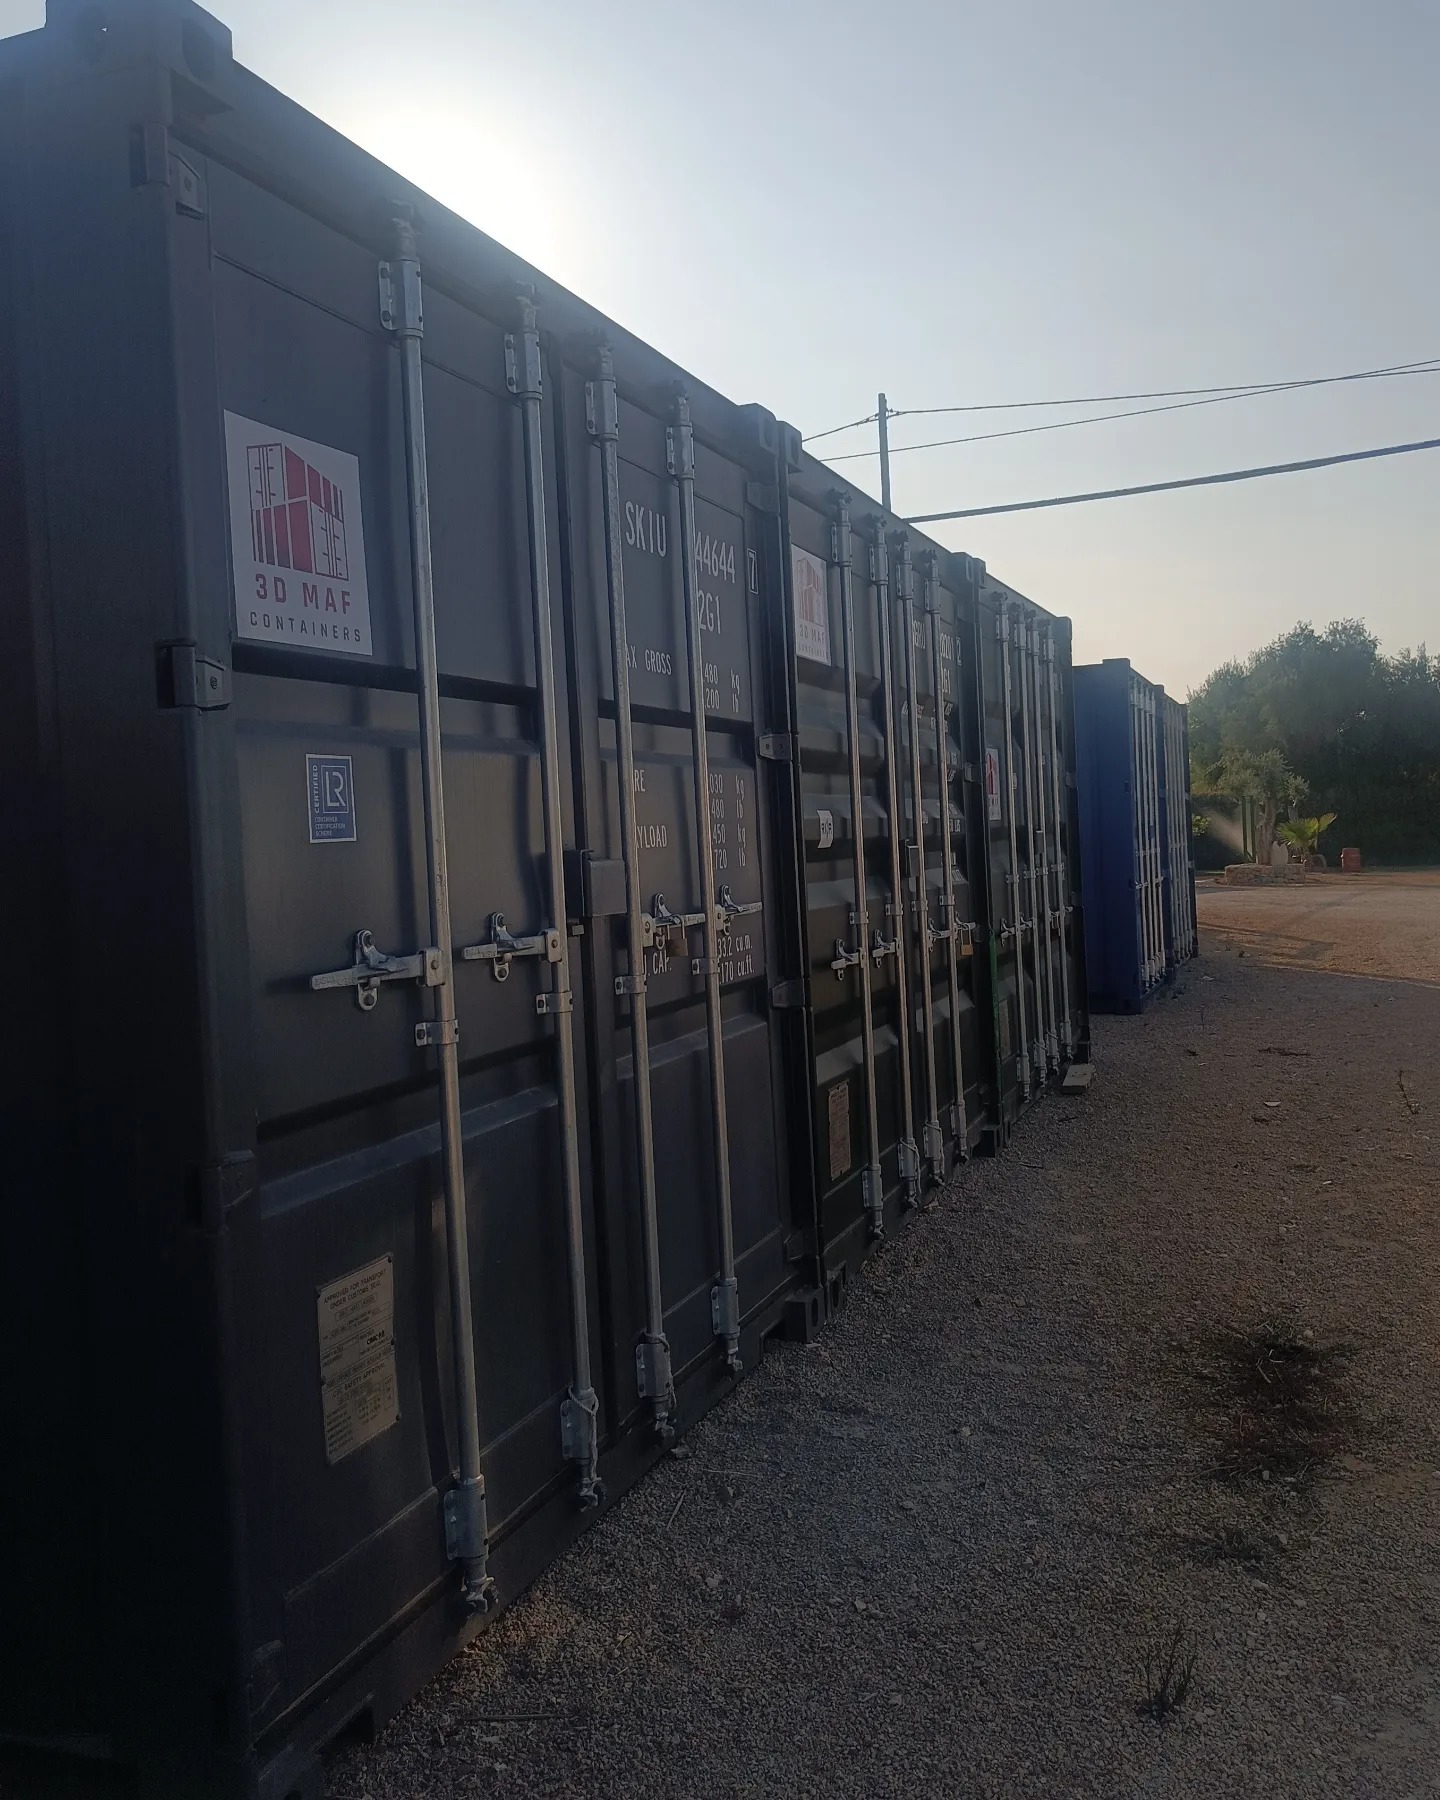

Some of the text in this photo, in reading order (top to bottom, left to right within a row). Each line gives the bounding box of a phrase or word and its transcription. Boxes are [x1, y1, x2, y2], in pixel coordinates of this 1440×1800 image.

[625, 501, 666, 557] SKIU
[695, 531, 735, 583] 44644
[255, 574, 351, 614] 3D MAF
[250, 612, 361, 642] CONTAINERS
[698, 589, 720, 634] 2G1
[626, 645, 637, 668] AX
[645, 649, 671, 675] GROSS
[731, 668, 740, 695] kg
[326, 771, 347, 807] LR
[634, 769, 646, 792] RE
[736, 775, 744, 800] kg
[711, 798, 743, 818] 480 lb
[636, 825, 667, 848] YLOAD
[737, 823, 746, 848] kg
[739, 847, 745, 867] lb
